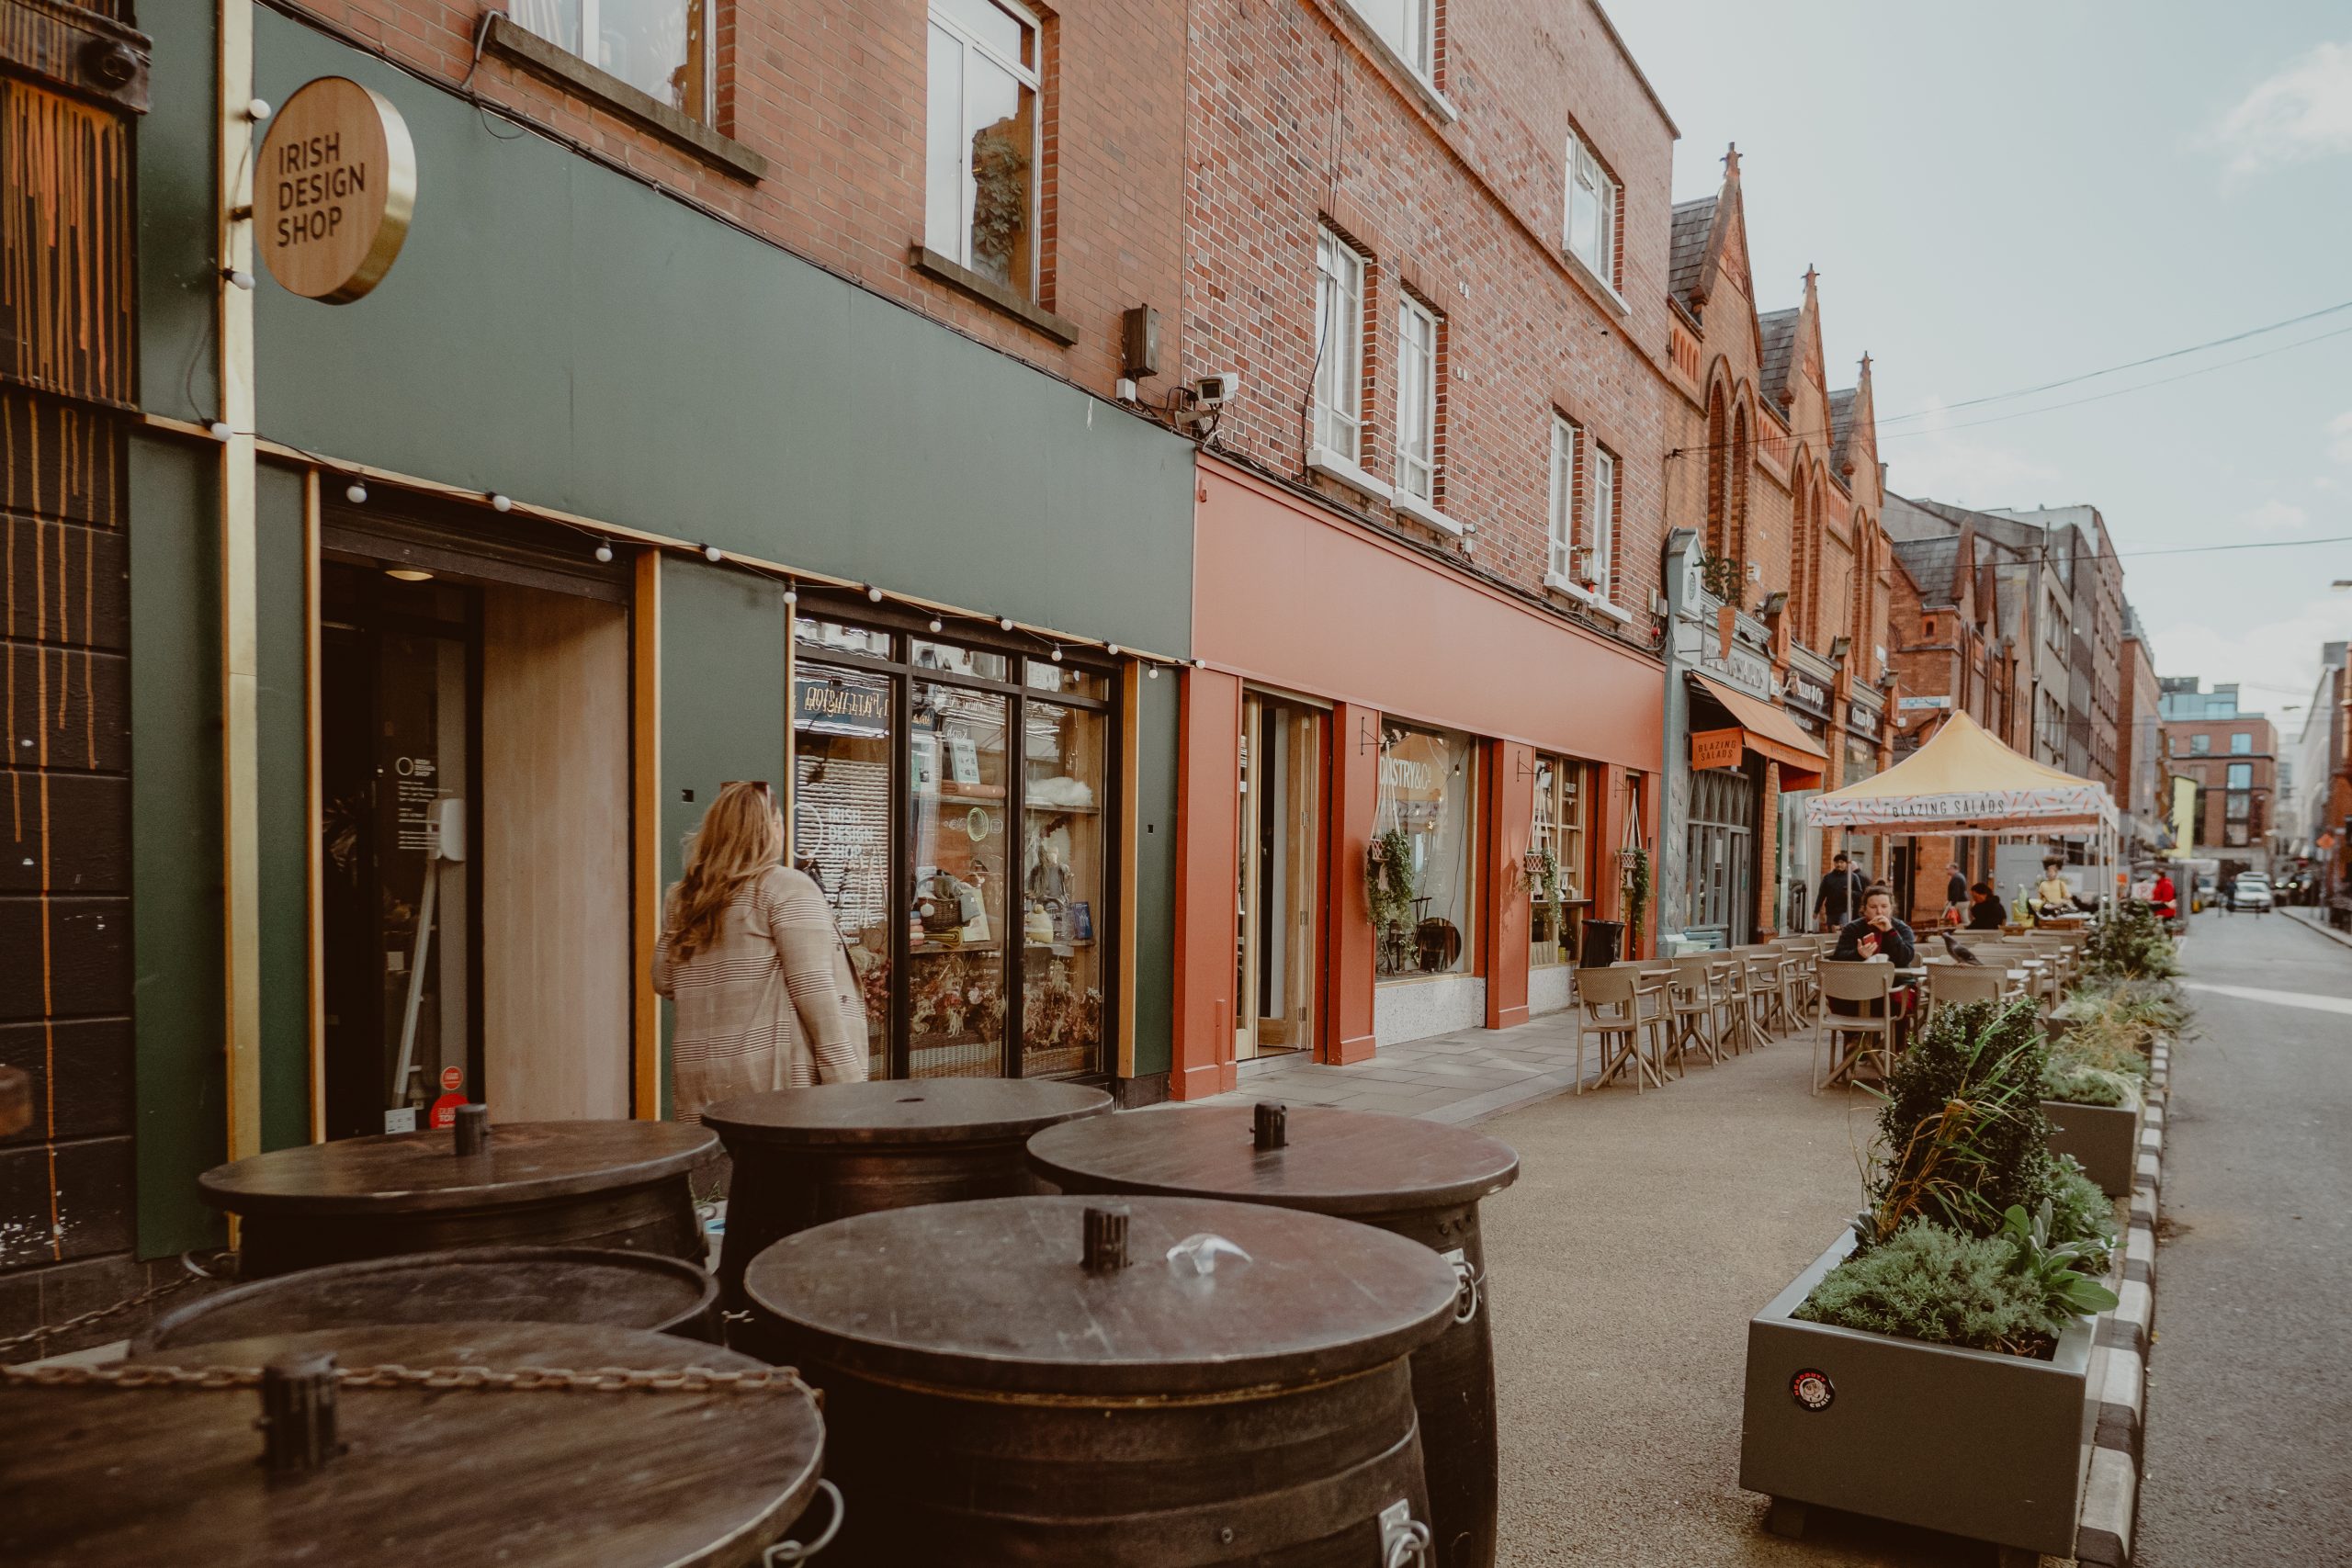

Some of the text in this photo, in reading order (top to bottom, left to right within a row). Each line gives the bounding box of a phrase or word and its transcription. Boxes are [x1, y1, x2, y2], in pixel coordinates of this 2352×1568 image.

[278, 131, 340, 176] IRISH
[278, 162, 366, 212] DESIGN
[277, 206, 343, 248] SHOP
[1698, 739, 1736, 753] BLAZING
[1701, 748, 1734, 762] SALADS
[829, 807, 861, 823] IRISH
[1892, 799, 2005, 818] BLAZING SALADS
[829, 825, 875, 843] DESIGN
[1809, 1393, 1831, 1408] CRAIG
